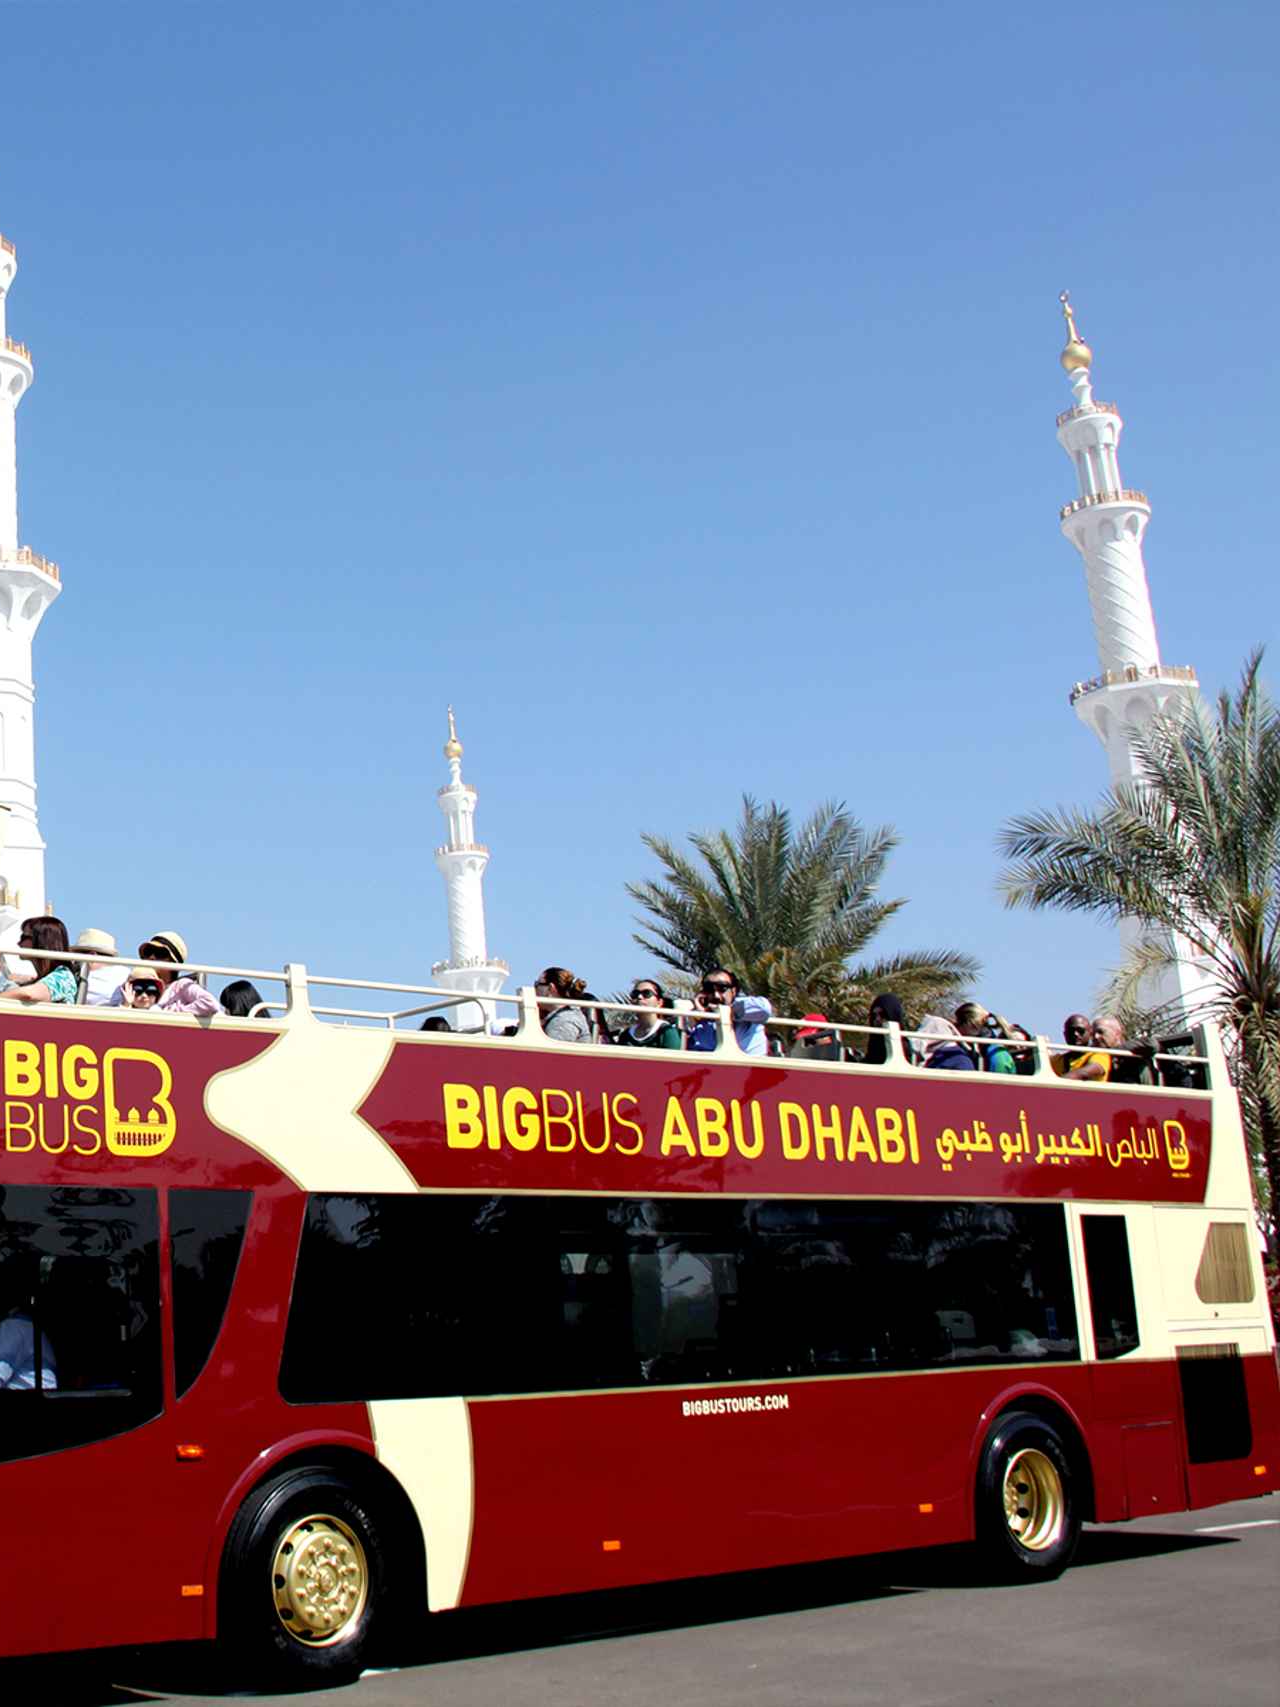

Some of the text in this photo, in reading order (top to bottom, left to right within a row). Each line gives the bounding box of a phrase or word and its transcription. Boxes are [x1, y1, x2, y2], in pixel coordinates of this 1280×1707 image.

[3, 1039, 100, 1101] BIG
[4, 1100, 102, 1156] BUS
[660, 1095, 765, 1160] ABU
[777, 1101, 920, 1165] DHABI
[935, 1108, 1160, 1172] الباص الكبير أبو ظبي
[681, 1394, 790, 1417] BIGBUSTOURS.COM
